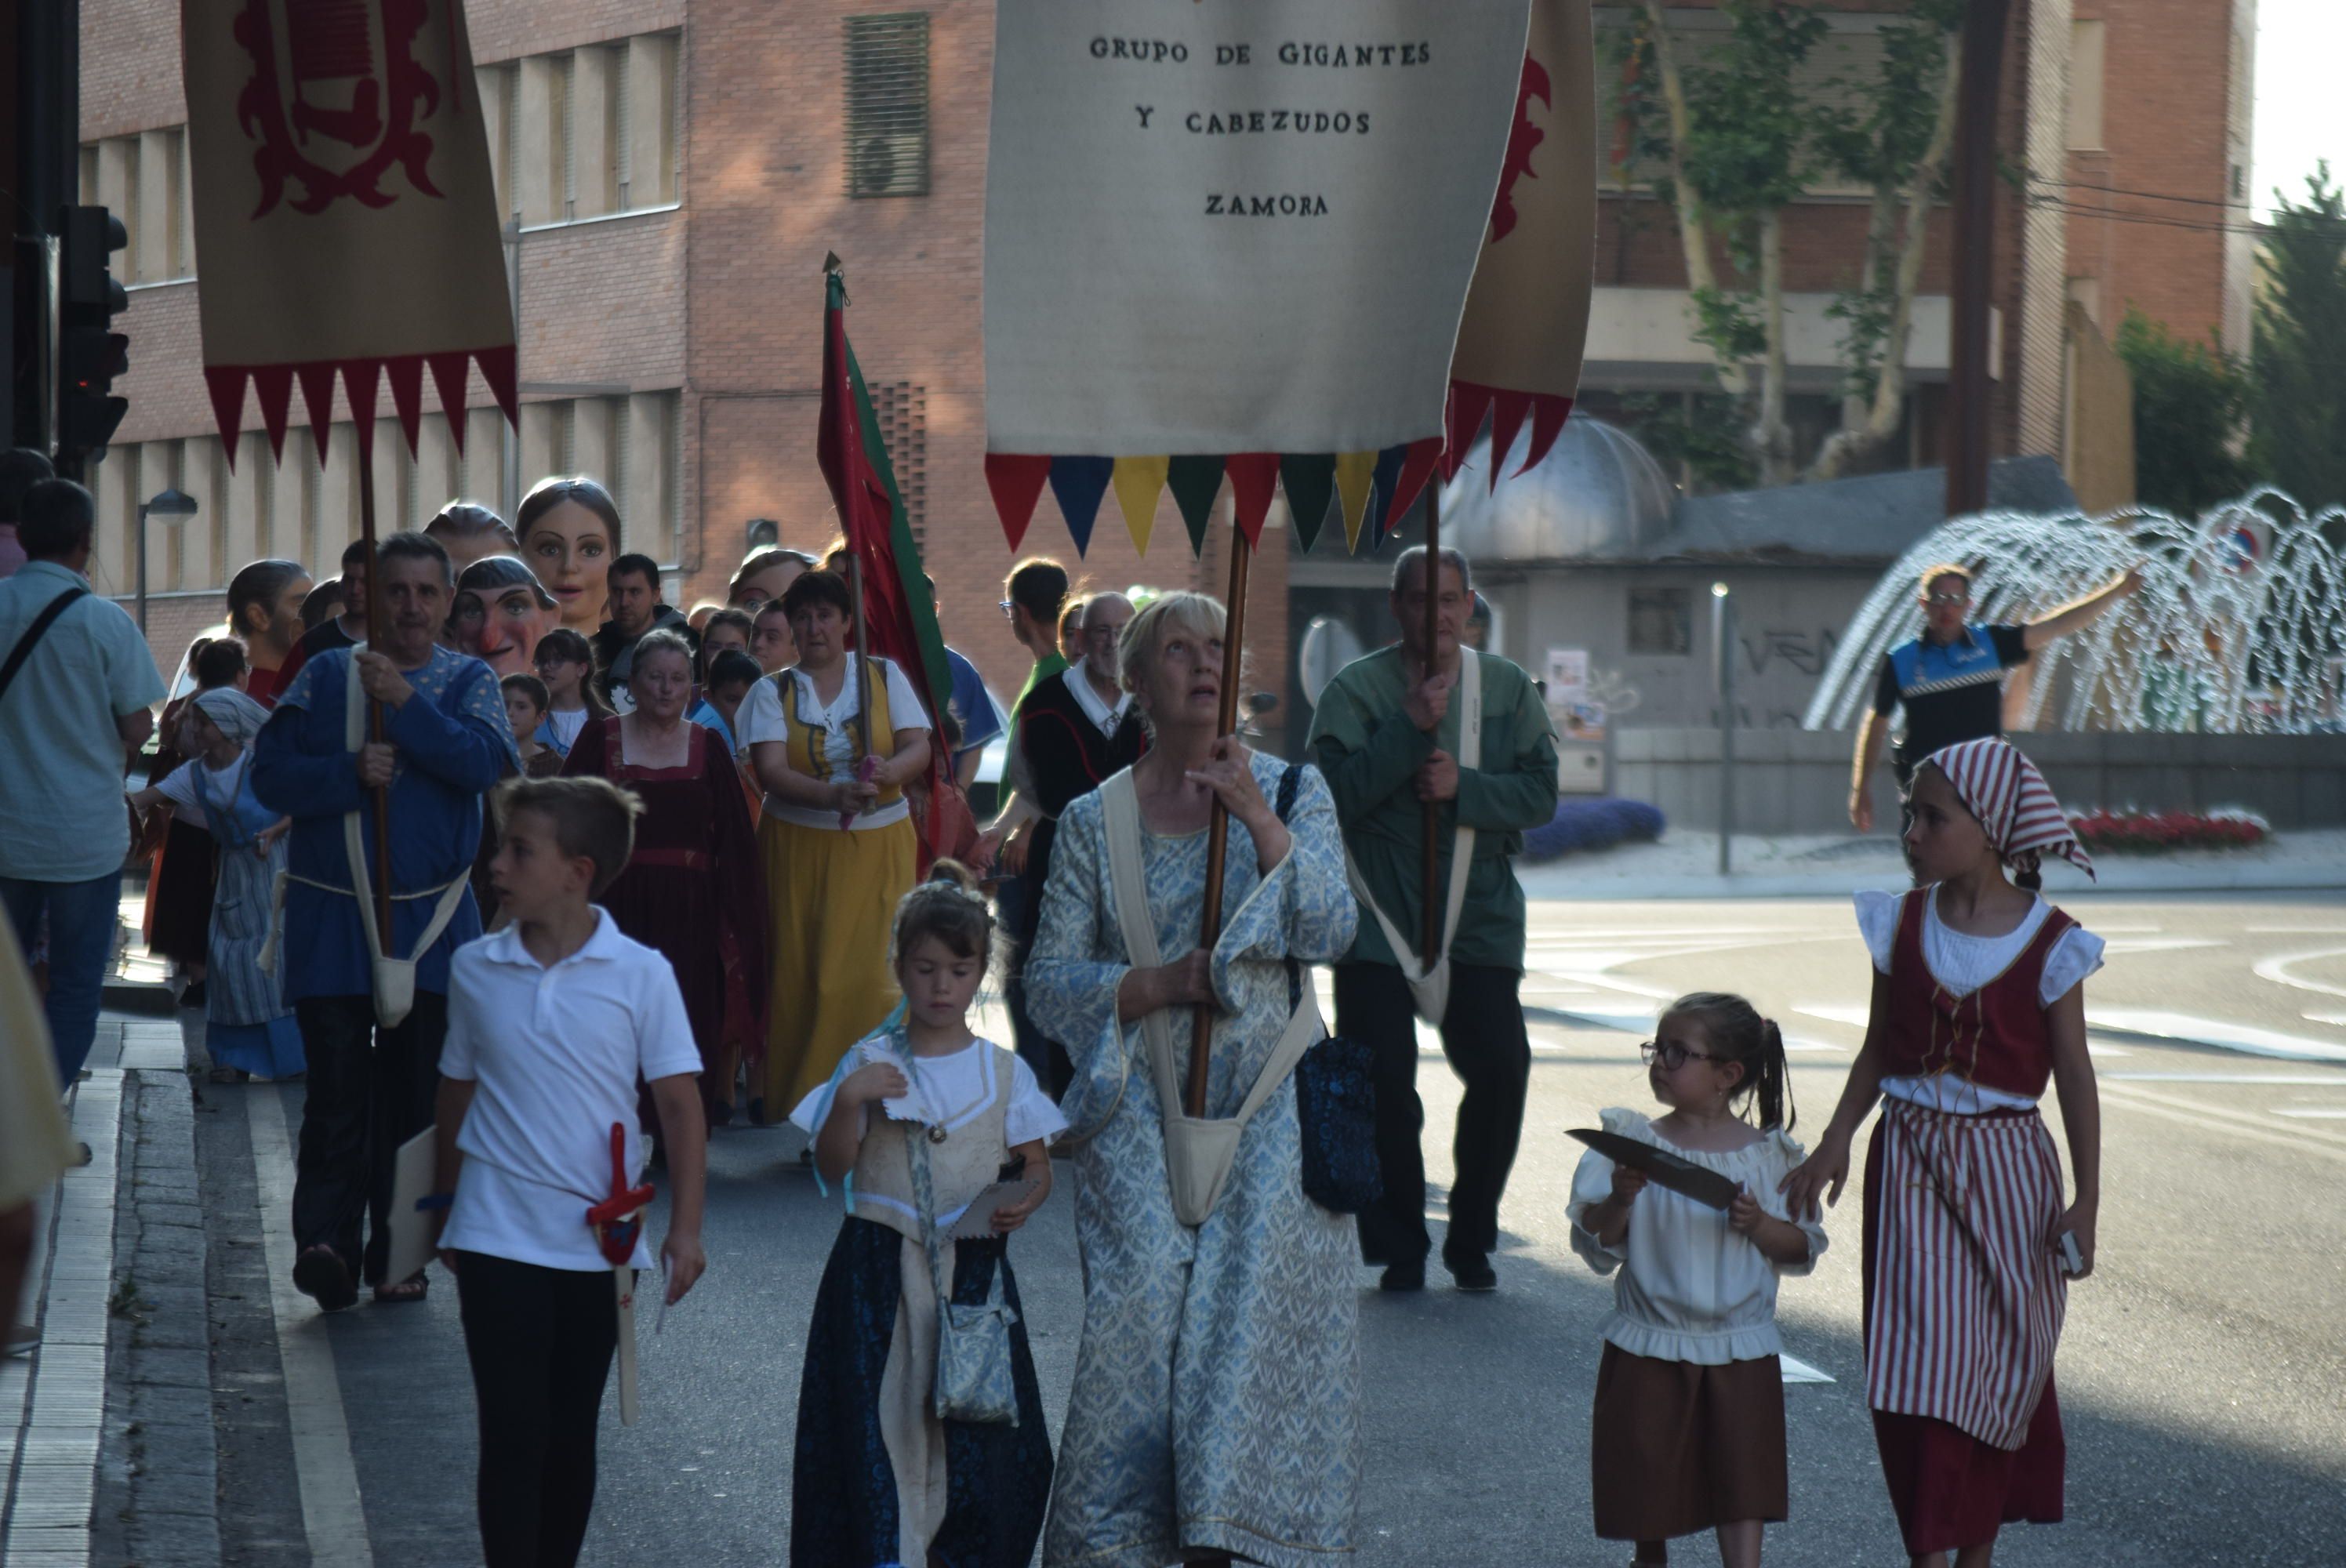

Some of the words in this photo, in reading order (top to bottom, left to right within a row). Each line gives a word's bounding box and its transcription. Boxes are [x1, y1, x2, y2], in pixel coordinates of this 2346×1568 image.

[1089, 36, 1189, 64] GRUPO
[1215, 43, 1251, 66] DE
[1278, 42, 1430, 68] GIGANTES
[1135, 104, 1155, 129] Y
[1185, 111, 1371, 135] CABEZUDOS
[1204, 194, 1329, 218] ZAMORA
